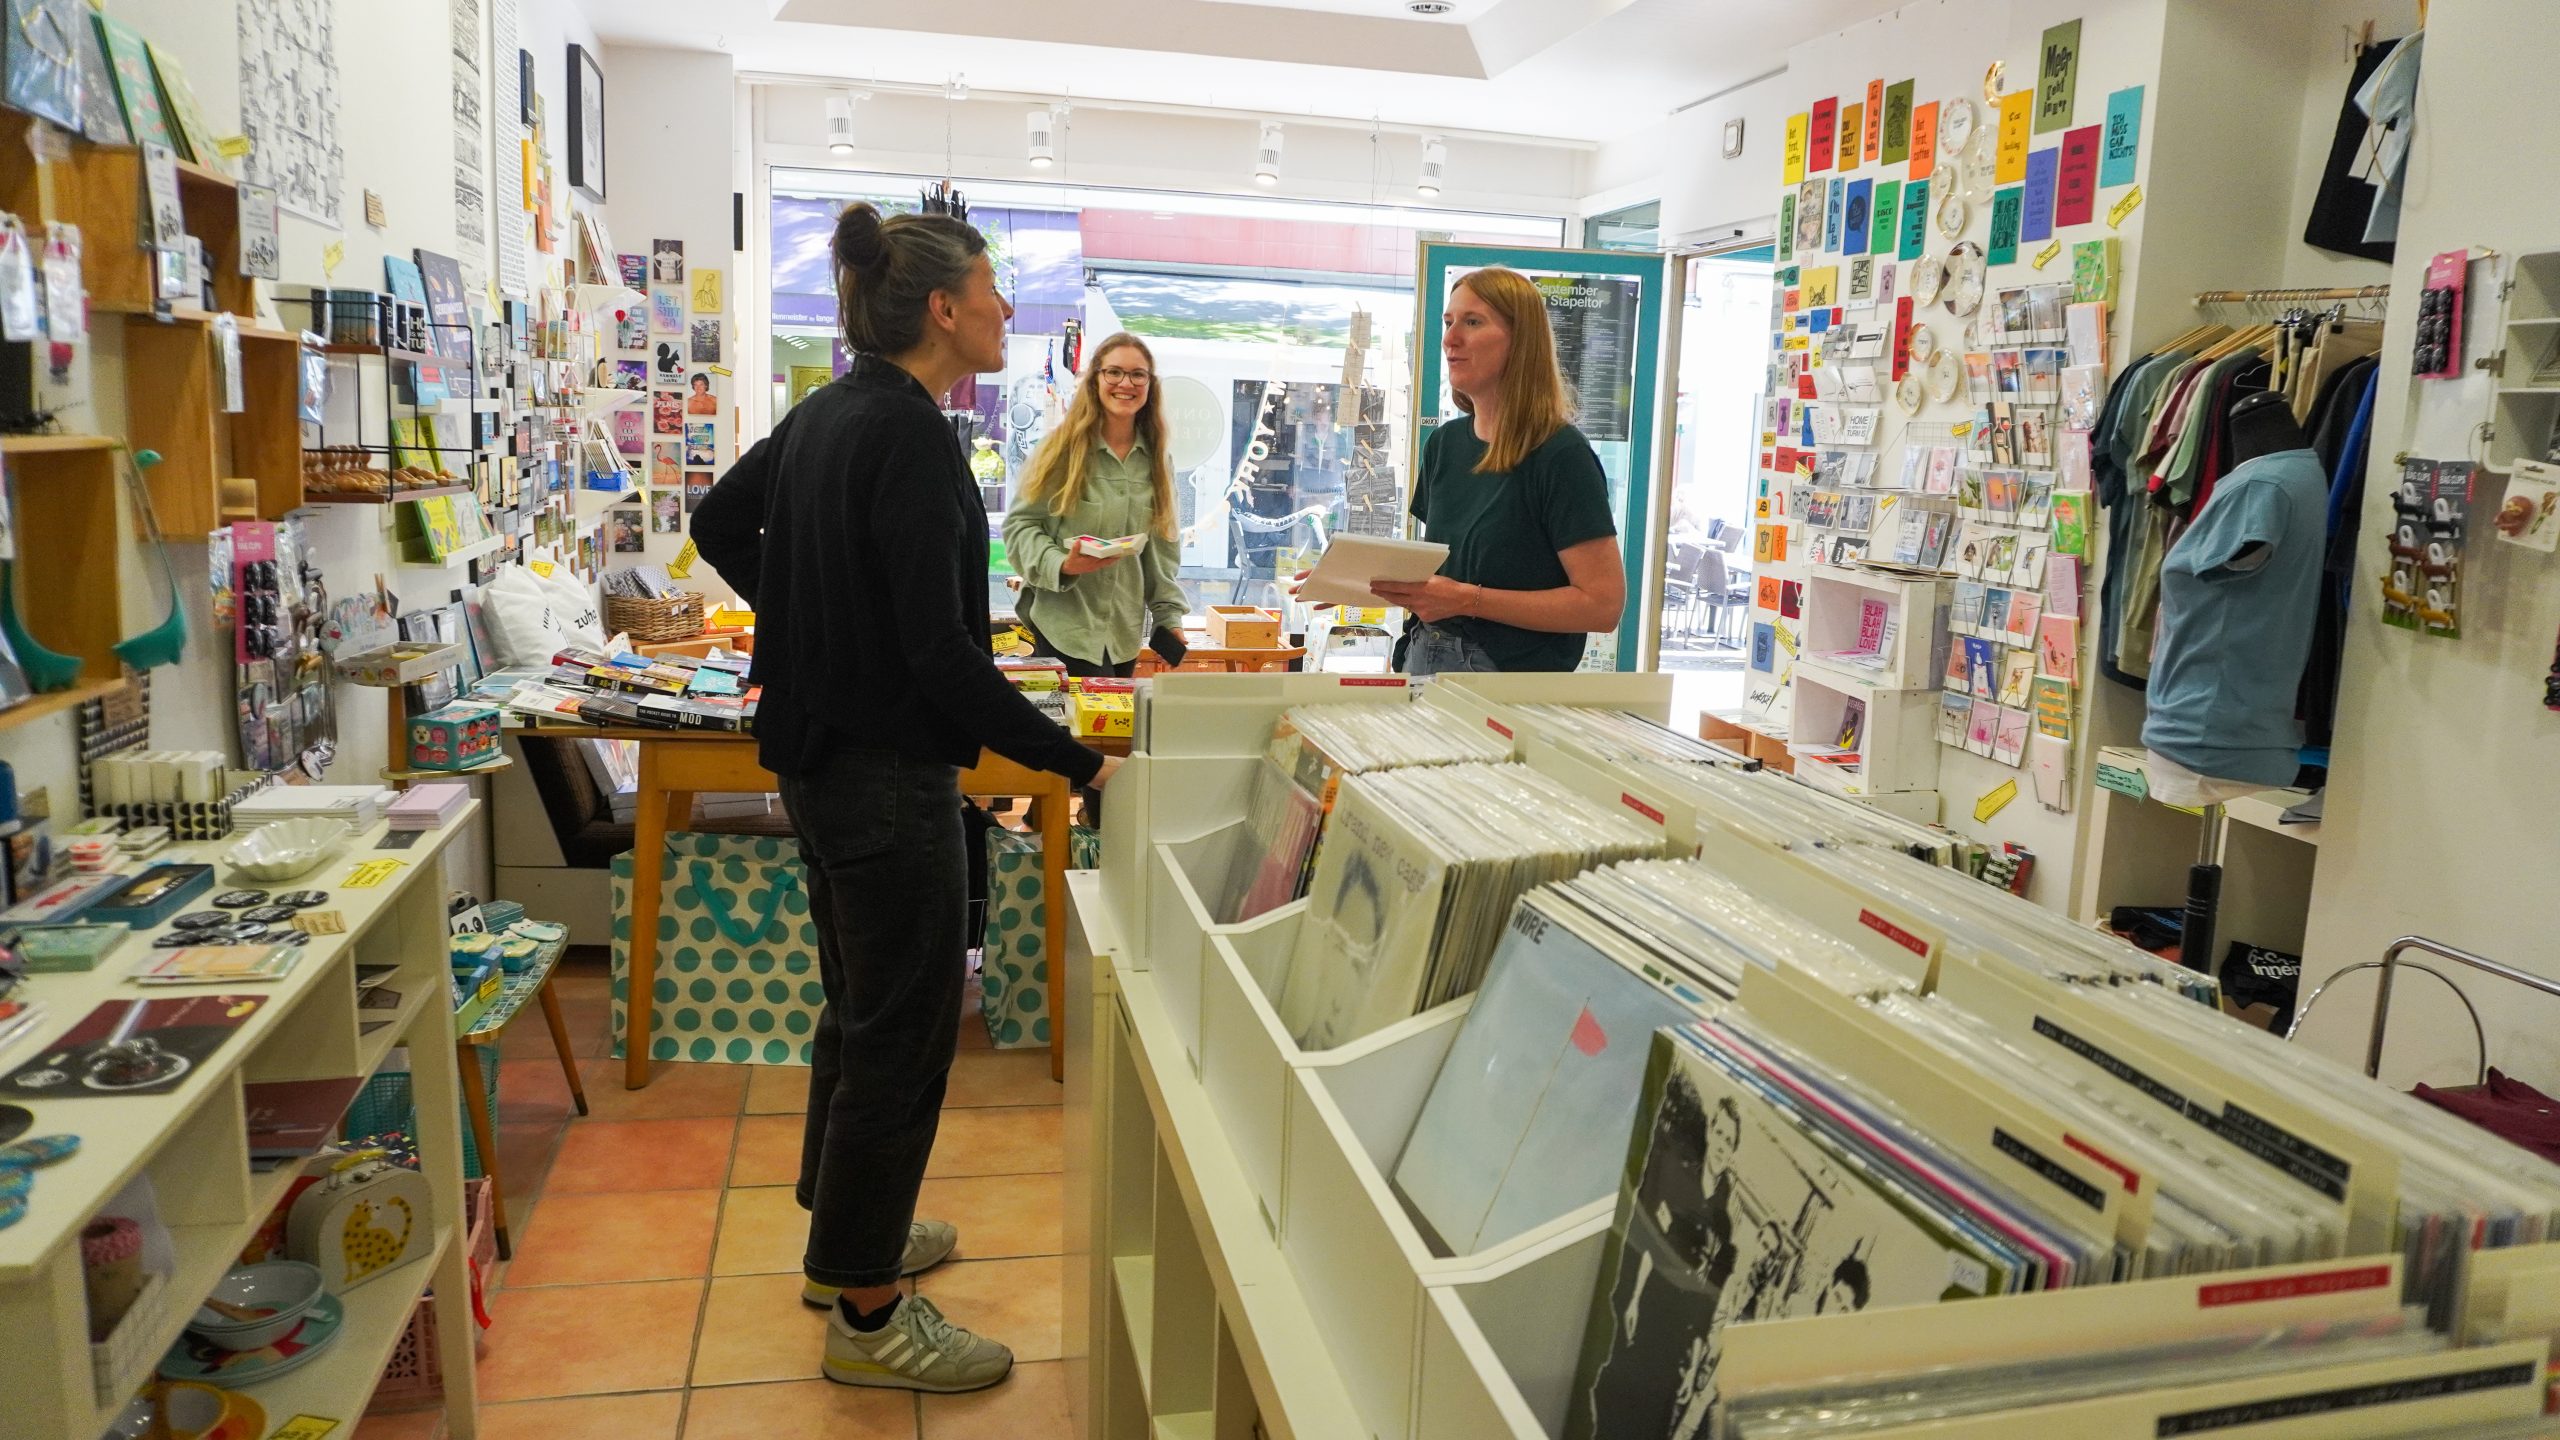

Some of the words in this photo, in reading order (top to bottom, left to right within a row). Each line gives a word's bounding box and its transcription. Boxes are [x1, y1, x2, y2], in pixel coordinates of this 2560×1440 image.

[1534, 282, 1599, 297] September
[658, 295, 678, 306] LET
[1551, 295, 1604, 309] Stapeltor
[1865, 604, 1884, 618] BLAH
[1863, 615, 1882, 629] BLAH
[1861, 626, 1880, 640] BLAH
[1859, 638, 1877, 651] LOVE
[679, 712, 702, 726] MOD
[1512, 909, 1549, 945] WIRE
